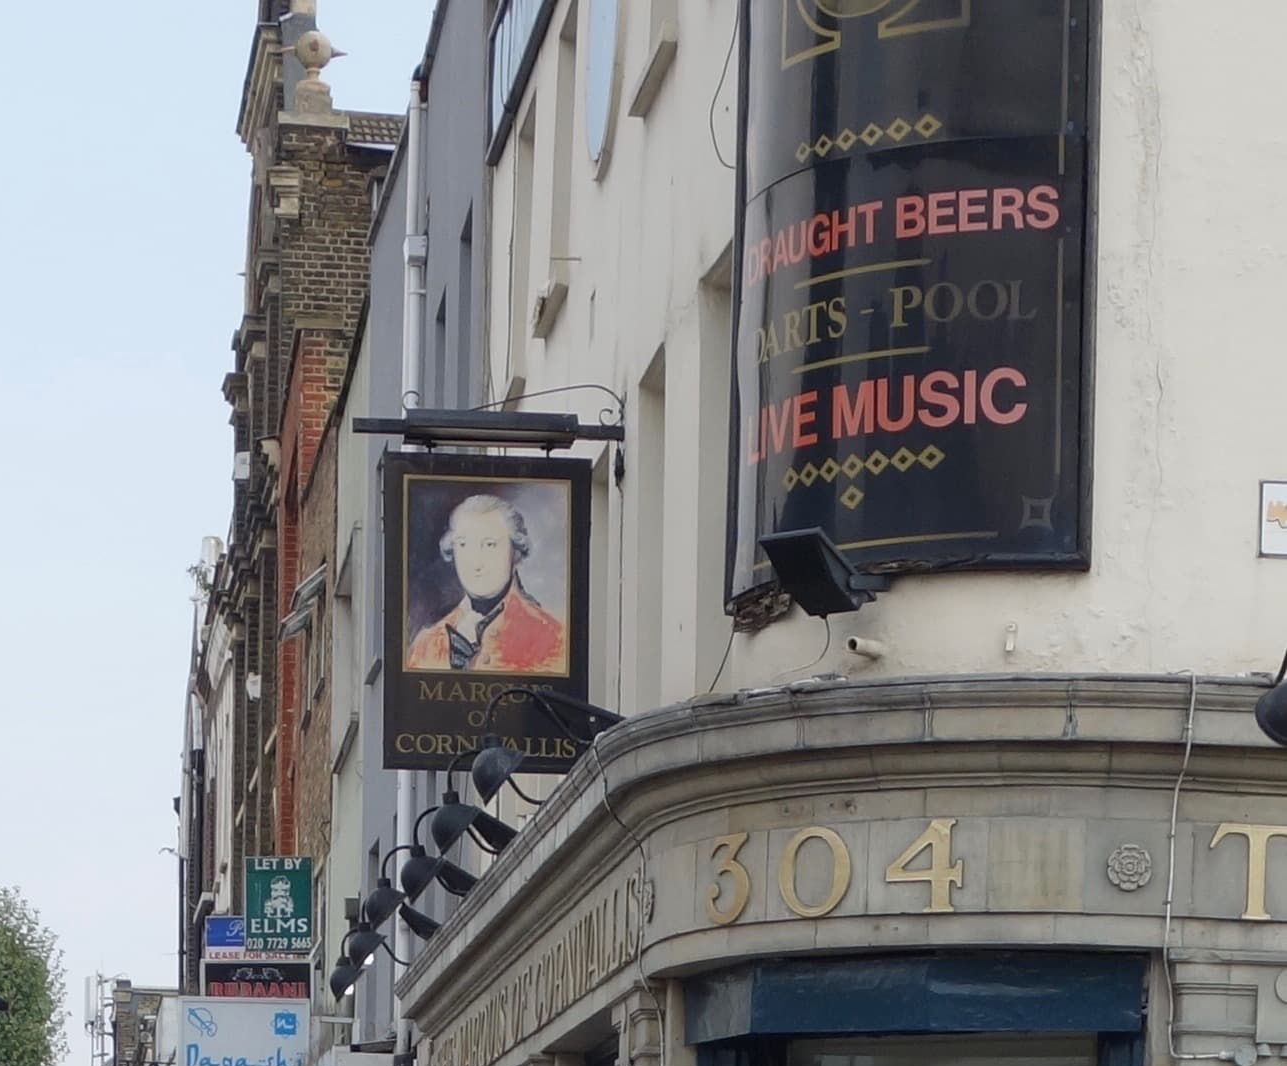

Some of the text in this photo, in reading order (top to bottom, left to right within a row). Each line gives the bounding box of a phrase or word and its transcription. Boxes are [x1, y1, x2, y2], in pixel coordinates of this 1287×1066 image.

[747, 184, 1059, 287] DRAUGHT BEERS
[753, 296, 848, 364] DARTS
[889, 279, 1037, 328] POOL
[745, 367, 1028, 466] LIVE MUSIC
[468, 711, 497, 727] O
[255, 858, 302, 870] LET BY
[705, 817, 964, 925] 304
[247, 938, 264, 949] 020
[267, 938, 288, 949] 7729
[251, 918, 308, 933] ELMS
[511, 965, 533, 1044] OF
[535, 873, 641, 1026] CORNWALLIS
